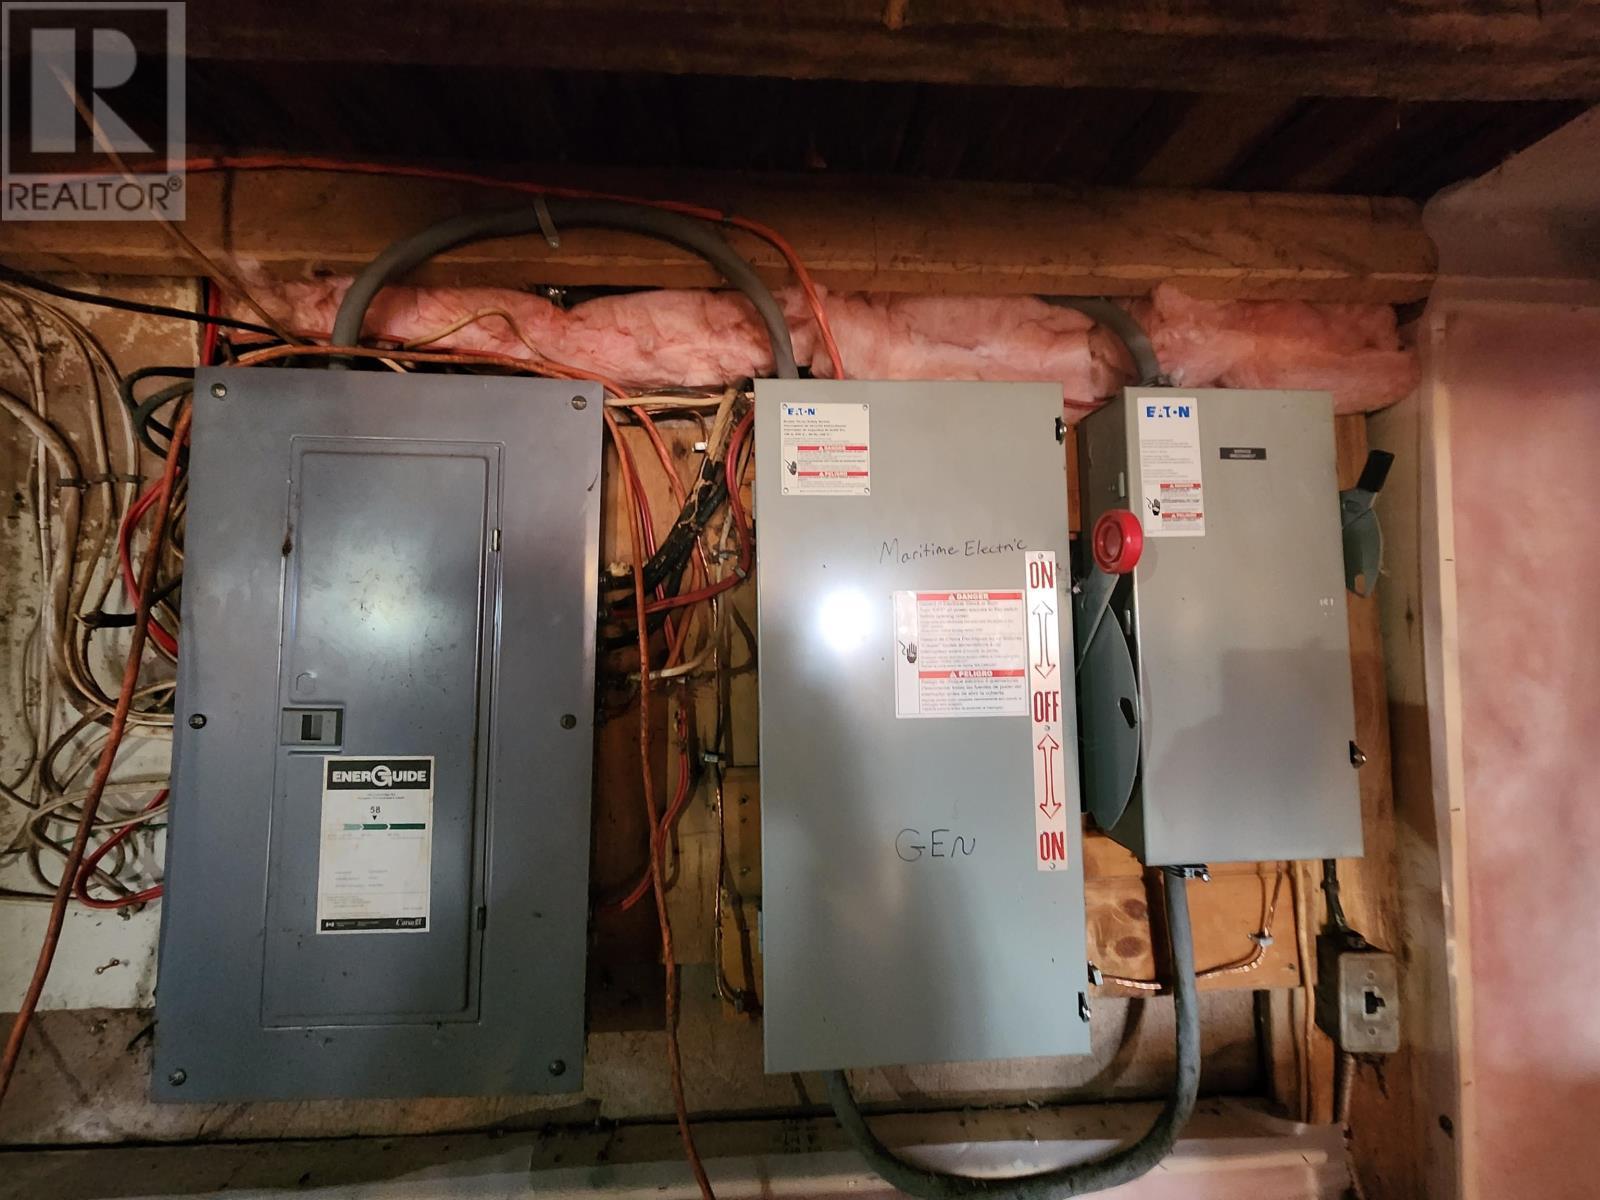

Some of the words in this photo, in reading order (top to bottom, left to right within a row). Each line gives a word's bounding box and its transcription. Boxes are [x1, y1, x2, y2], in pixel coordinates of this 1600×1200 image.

[880, 538, 960, 565] Maritime
[964, 538, 1028, 557] Electric
[1029, 560, 1054, 589] ON
[959, 670, 993, 678] PELIGRO
[1033, 691, 1060, 723] OFF
[370, 806, 381, 814] 58
[895, 828, 976, 863] GEN
[1039, 831, 1065, 860] ON
